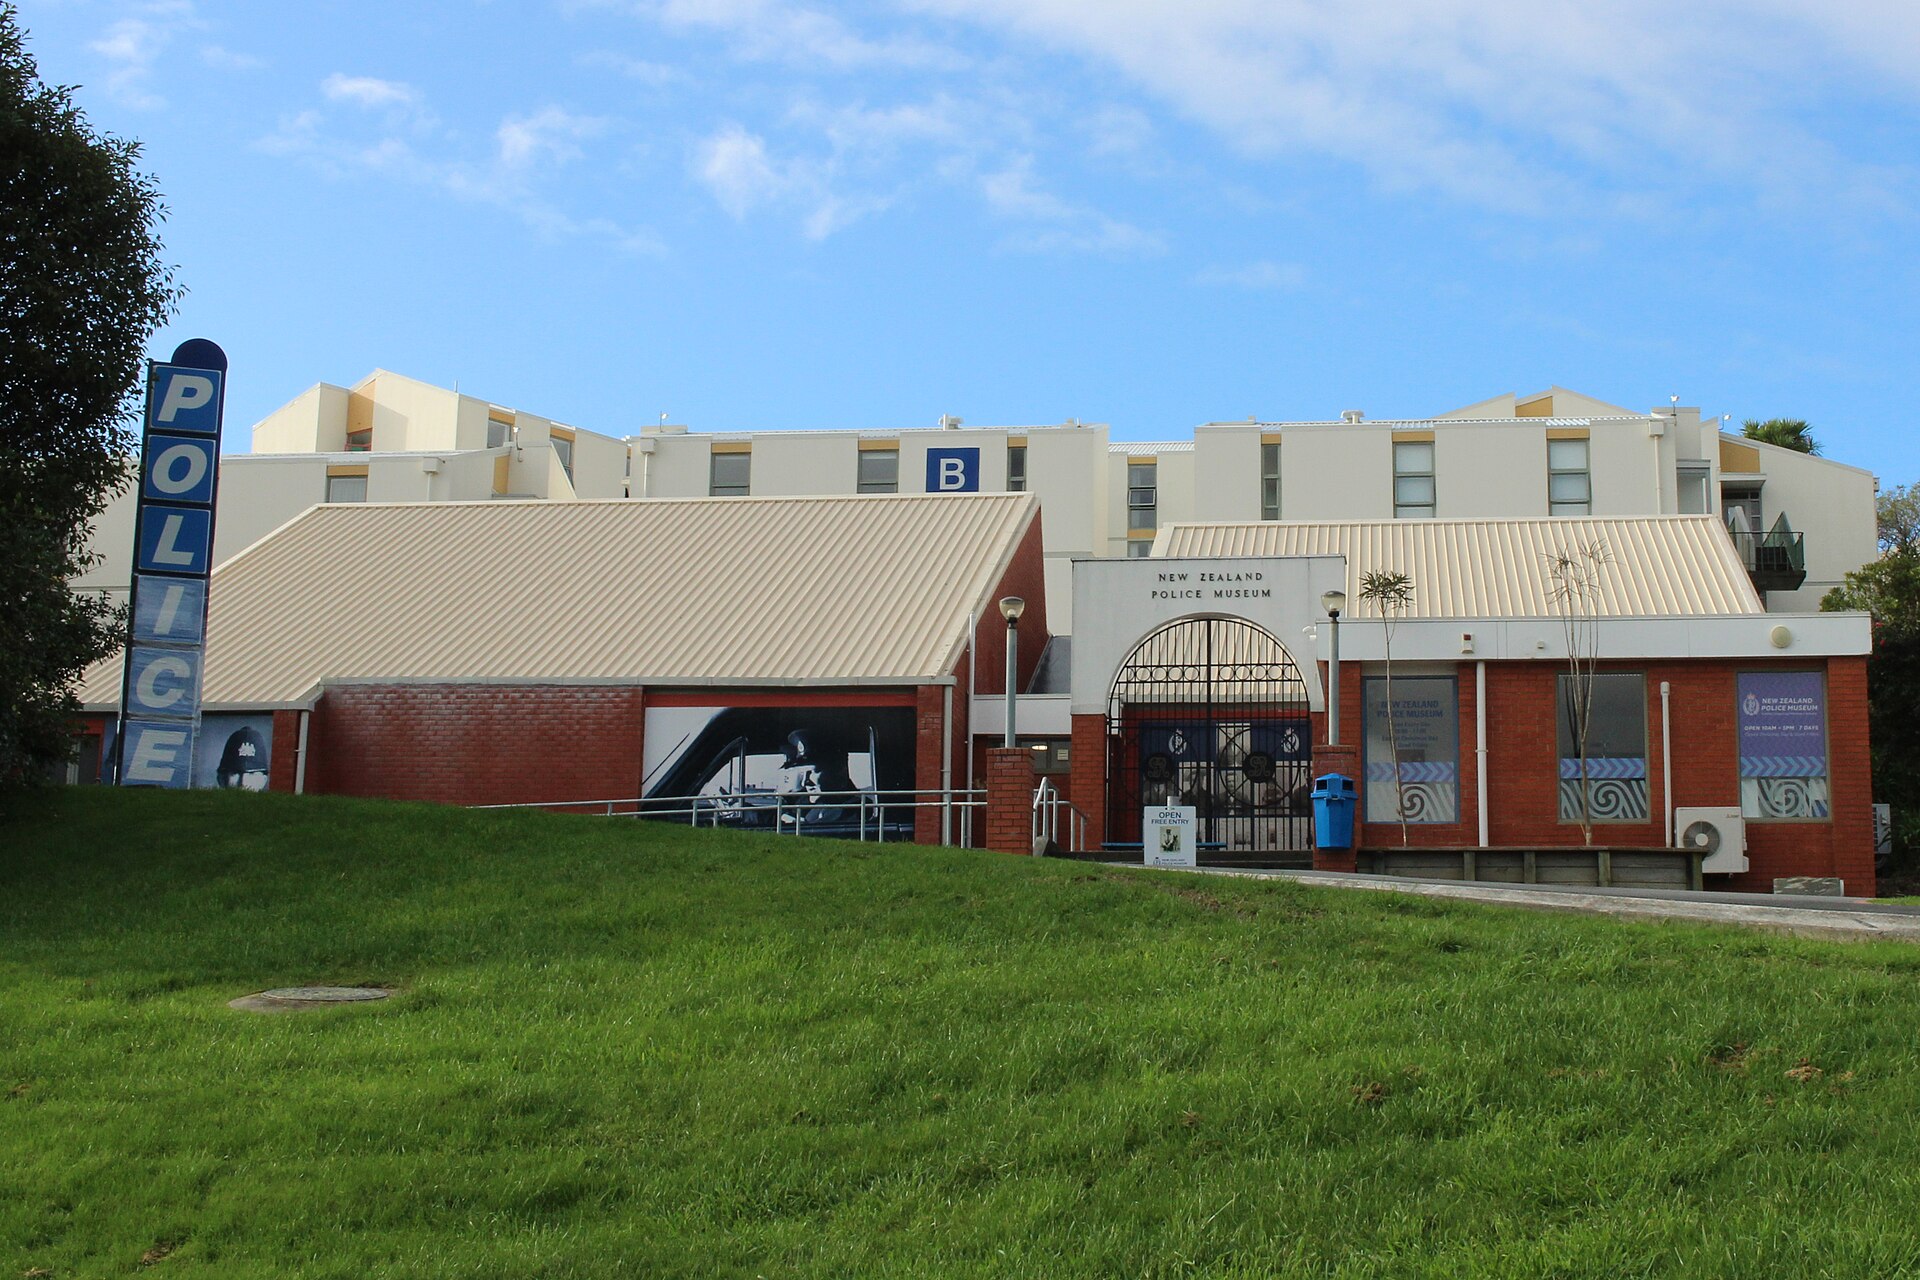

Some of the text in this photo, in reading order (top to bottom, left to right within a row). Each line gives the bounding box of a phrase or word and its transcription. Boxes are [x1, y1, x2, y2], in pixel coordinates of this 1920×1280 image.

[940, 458, 965, 490] B
[127, 373, 214, 783] POLICE
[1158, 572, 1263, 582] NEW ZEALAND
[1151, 589, 1271, 599] POLICE MUSEUM
[1376, 710, 1404, 718] POICE
[1158, 811, 1182, 819] OPEN
